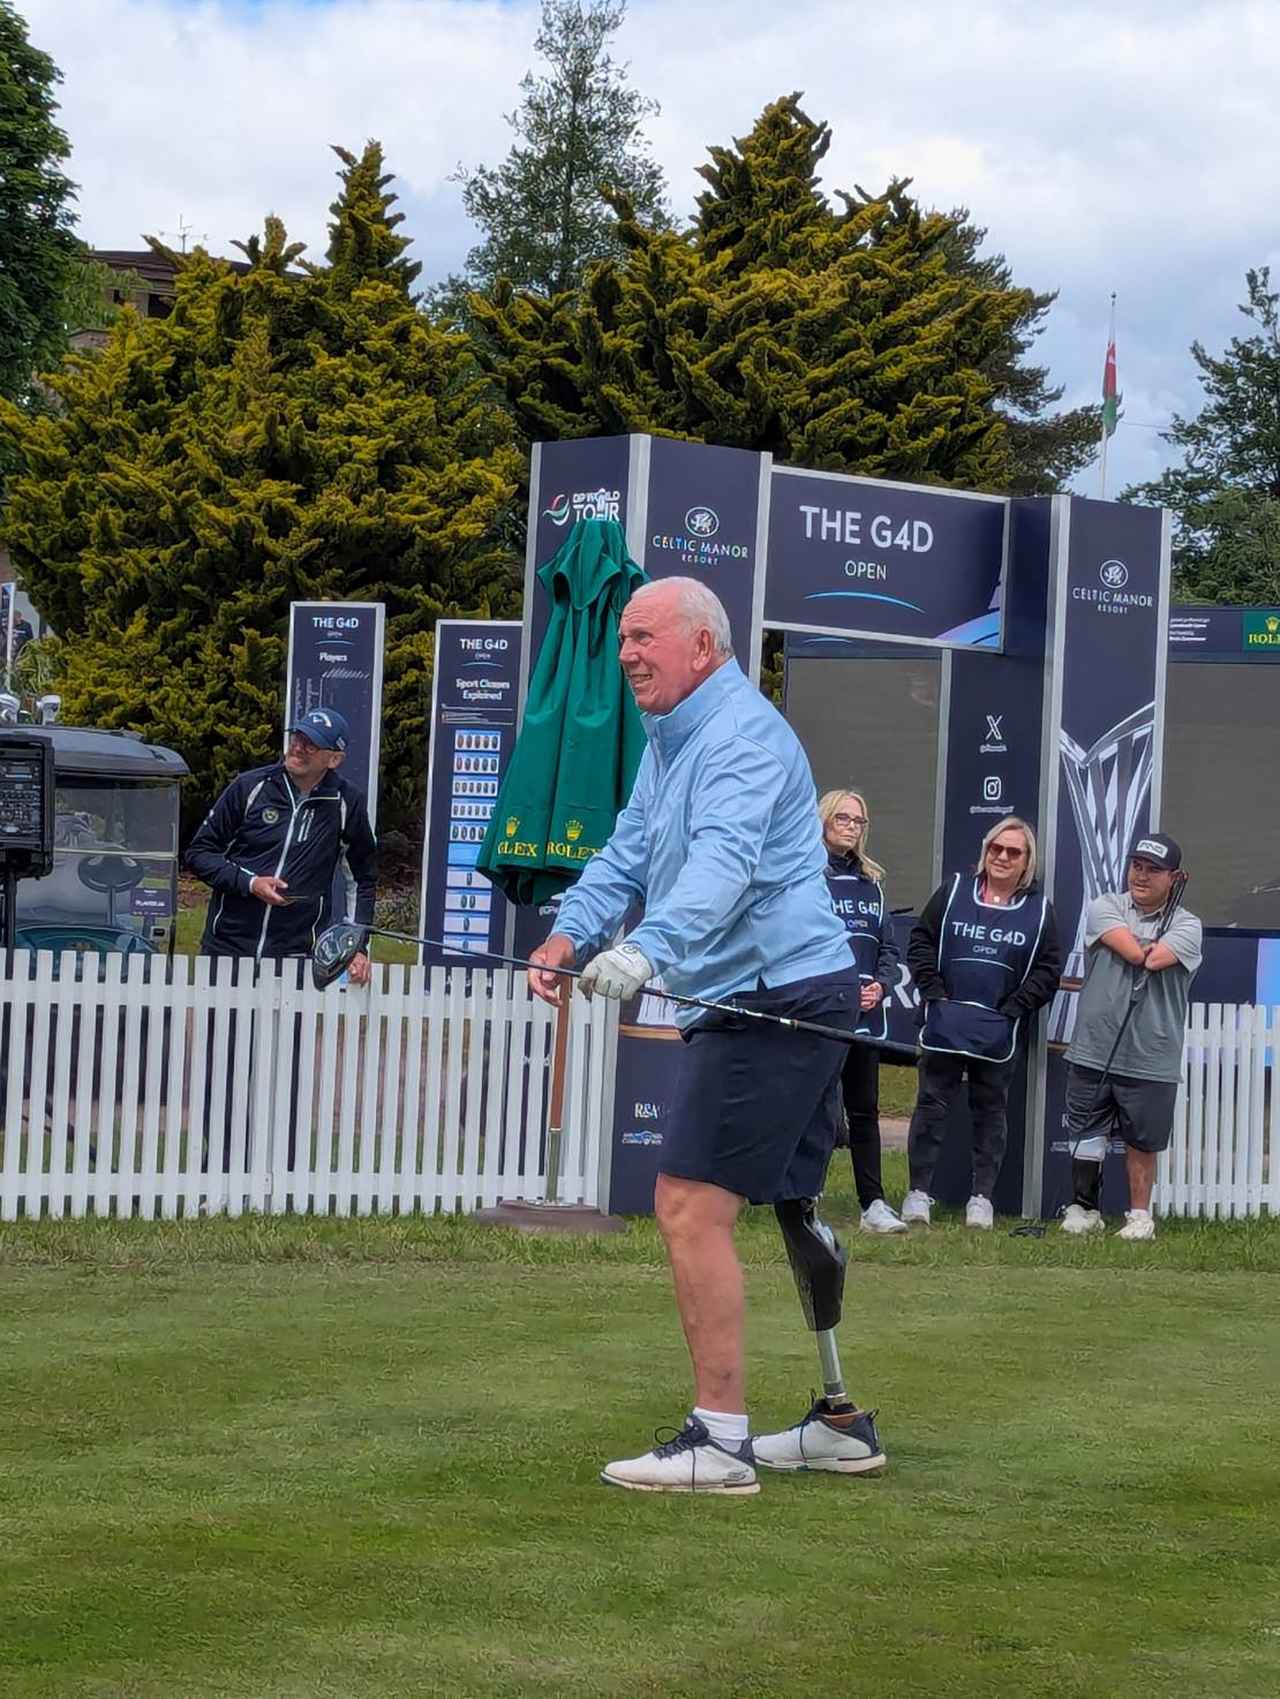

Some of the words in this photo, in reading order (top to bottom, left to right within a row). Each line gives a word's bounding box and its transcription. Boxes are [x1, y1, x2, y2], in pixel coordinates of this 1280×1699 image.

[573, 502, 619, 522] TOUR
[799, 504, 862, 544] THE
[870, 515, 934, 553] G4D
[652, 535, 696, 552] CELTIC
[700, 541, 748, 559] MANOR
[681, 553, 718, 566] RESORT
[844, 560, 887, 579] OPEN
[1072, 587, 1110, 602] CELTIC
[1113, 593, 1153, 608] MANOR
[1097, 603, 1128, 615] RESORT
[312, 617, 334, 628] THE
[336, 617, 359, 629] G4D
[459, 638, 483, 650] THE
[484, 638, 508, 650] G4D
[456, 679, 479, 689] Sport
[463, 690, 502, 701] Explained
[831, 899, 855, 914] HE
[857, 900, 880, 916] G4D
[952, 921, 985, 940] THE
[989, 931, 1026, 947] G4D
[634, 1102, 658, 1119] R&A
